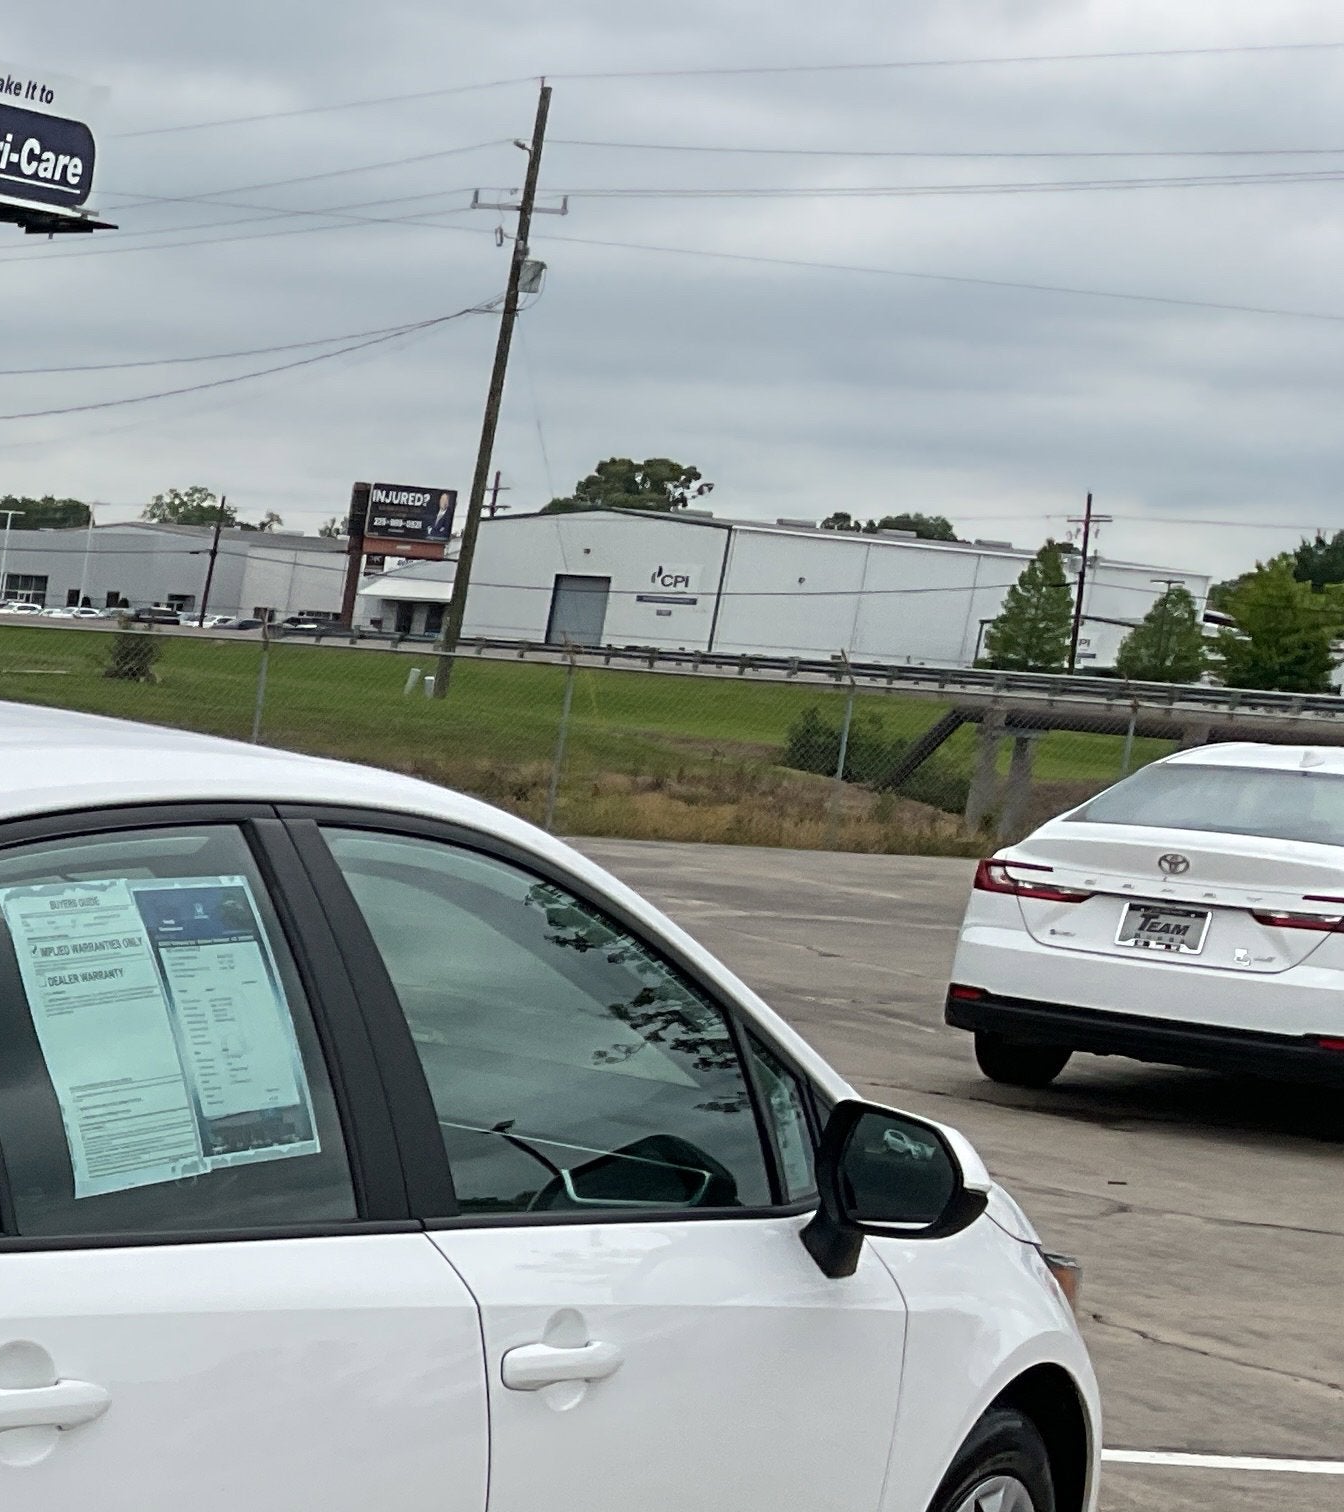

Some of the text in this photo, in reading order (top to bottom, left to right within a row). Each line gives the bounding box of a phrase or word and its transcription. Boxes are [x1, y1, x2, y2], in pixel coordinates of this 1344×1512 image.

[39, 84, 54, 104] to
[372, 488, 431, 507] INJURED?
[660, 574, 689, 588] CPI
[39, 937, 143, 957] IMPLIED WARRANTIES ONLY
[47, 968, 124, 987] DEALER WARRANTY
